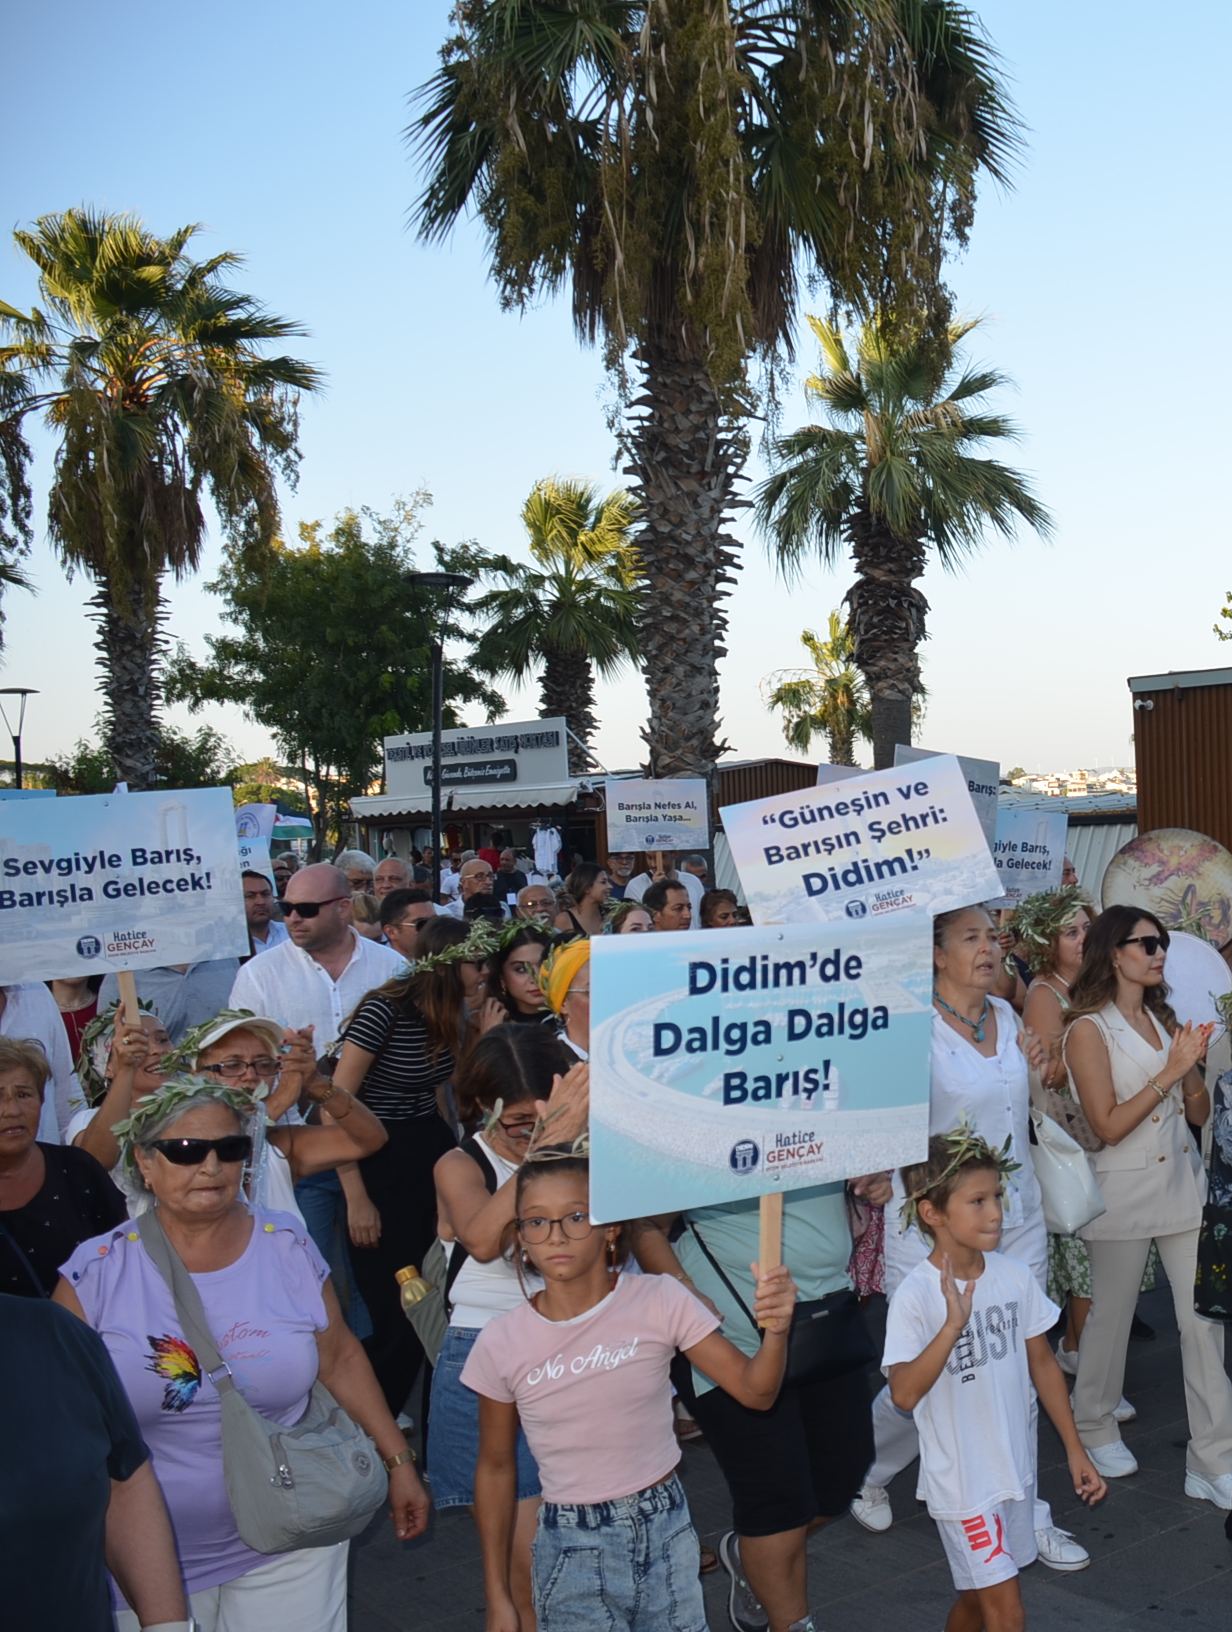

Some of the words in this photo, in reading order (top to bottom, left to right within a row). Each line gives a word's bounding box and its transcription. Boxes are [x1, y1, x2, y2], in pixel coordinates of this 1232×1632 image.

[896, 781, 930, 801] ve
[968, 780, 997, 797] Barış:
[618, 802, 652, 812] Barışla
[654, 801, 682, 810] Nefes
[684, 801, 697, 810] Al,
[625, 814, 659, 823] Barışla
[763, 829, 862, 866] Barışın
[868, 805, 949, 843] Şehri:
[1020, 841, 1050, 856] Barış,
[3, 850, 122, 878] Sevgiyle
[131, 847, 202, 867] Barış,
[1006, 857, 1052, 871] Gelecek!
[0, 883, 94, 910] Barışla
[102, 872, 213, 900] Gelecek!
[874, 889, 905, 902] Hatice
[871, 895, 913, 912] GENÇAY
[113, 930, 147, 942] Hatice
[107, 939, 155, 952] GENÇAY
[652, 1015, 772, 1058] Dalga
[786, 1002, 890, 1042] Dalga
[723, 1059, 832, 1107] Barış!
[775, 1130, 816, 1149] Hatice
[766, 1142, 824, 1164] GENÇAY
[527, 1353, 565, 1385] No
[570, 1337, 639, 1375] Angel
